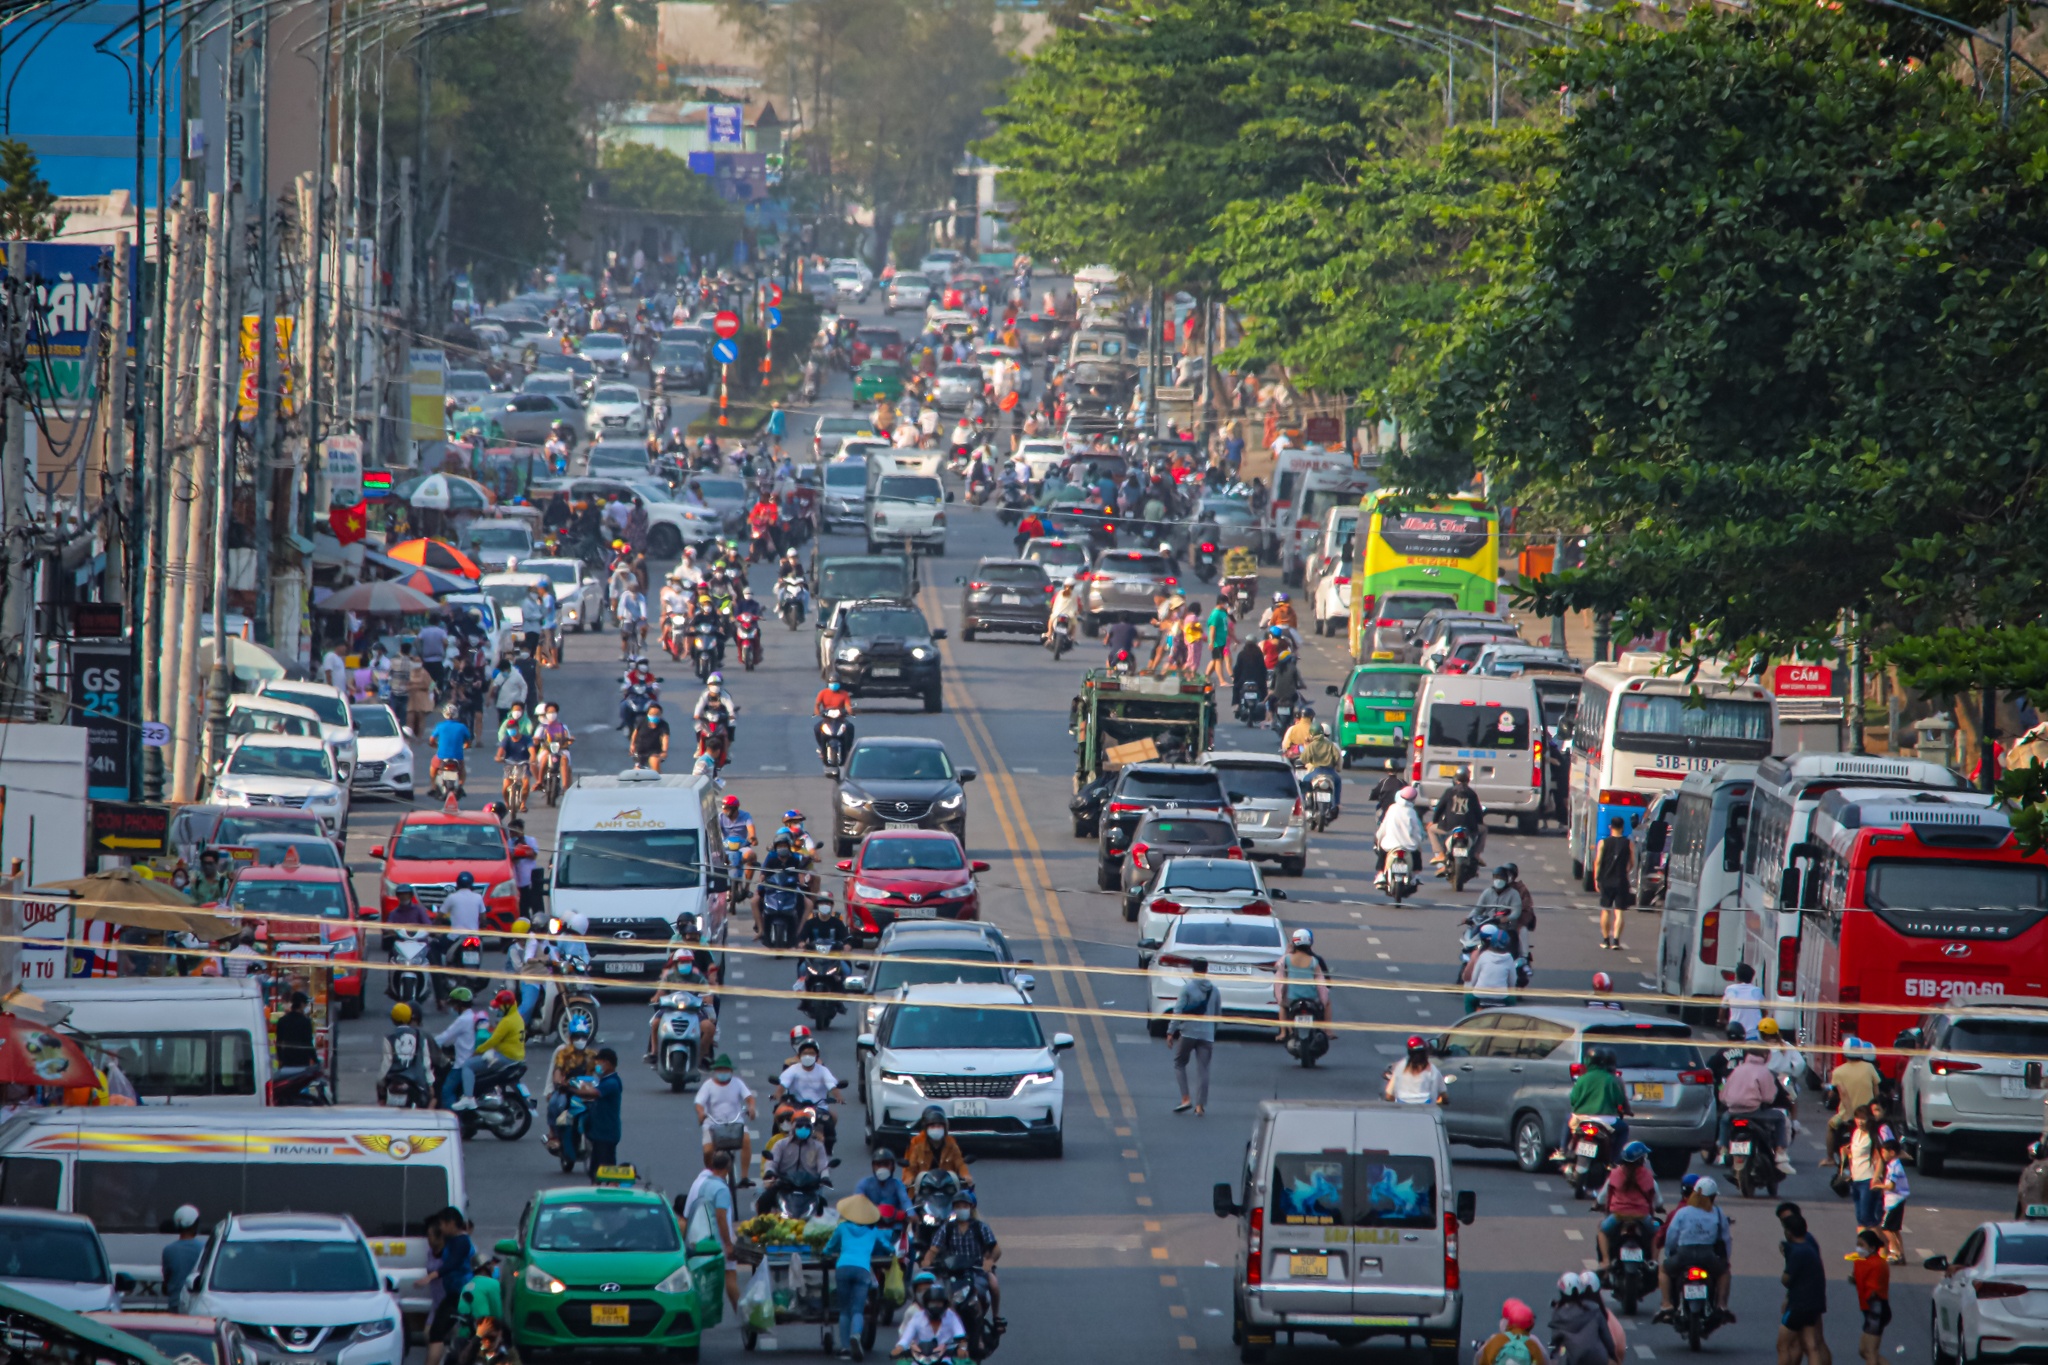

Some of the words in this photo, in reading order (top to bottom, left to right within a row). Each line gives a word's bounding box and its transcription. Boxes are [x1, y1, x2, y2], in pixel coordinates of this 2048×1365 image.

[82, 667, 121, 692] GS
[1790, 667, 1819, 681] CẤM
[82, 692, 121, 718] 25
[595, 820, 622, 829] ANH
[626, 818, 666, 829] QUỐC
[1907, 922, 2010, 935] UNIVERSE
[36, 958, 55, 979] TÚ
[273, 1145, 329, 1155] TRANSIT
